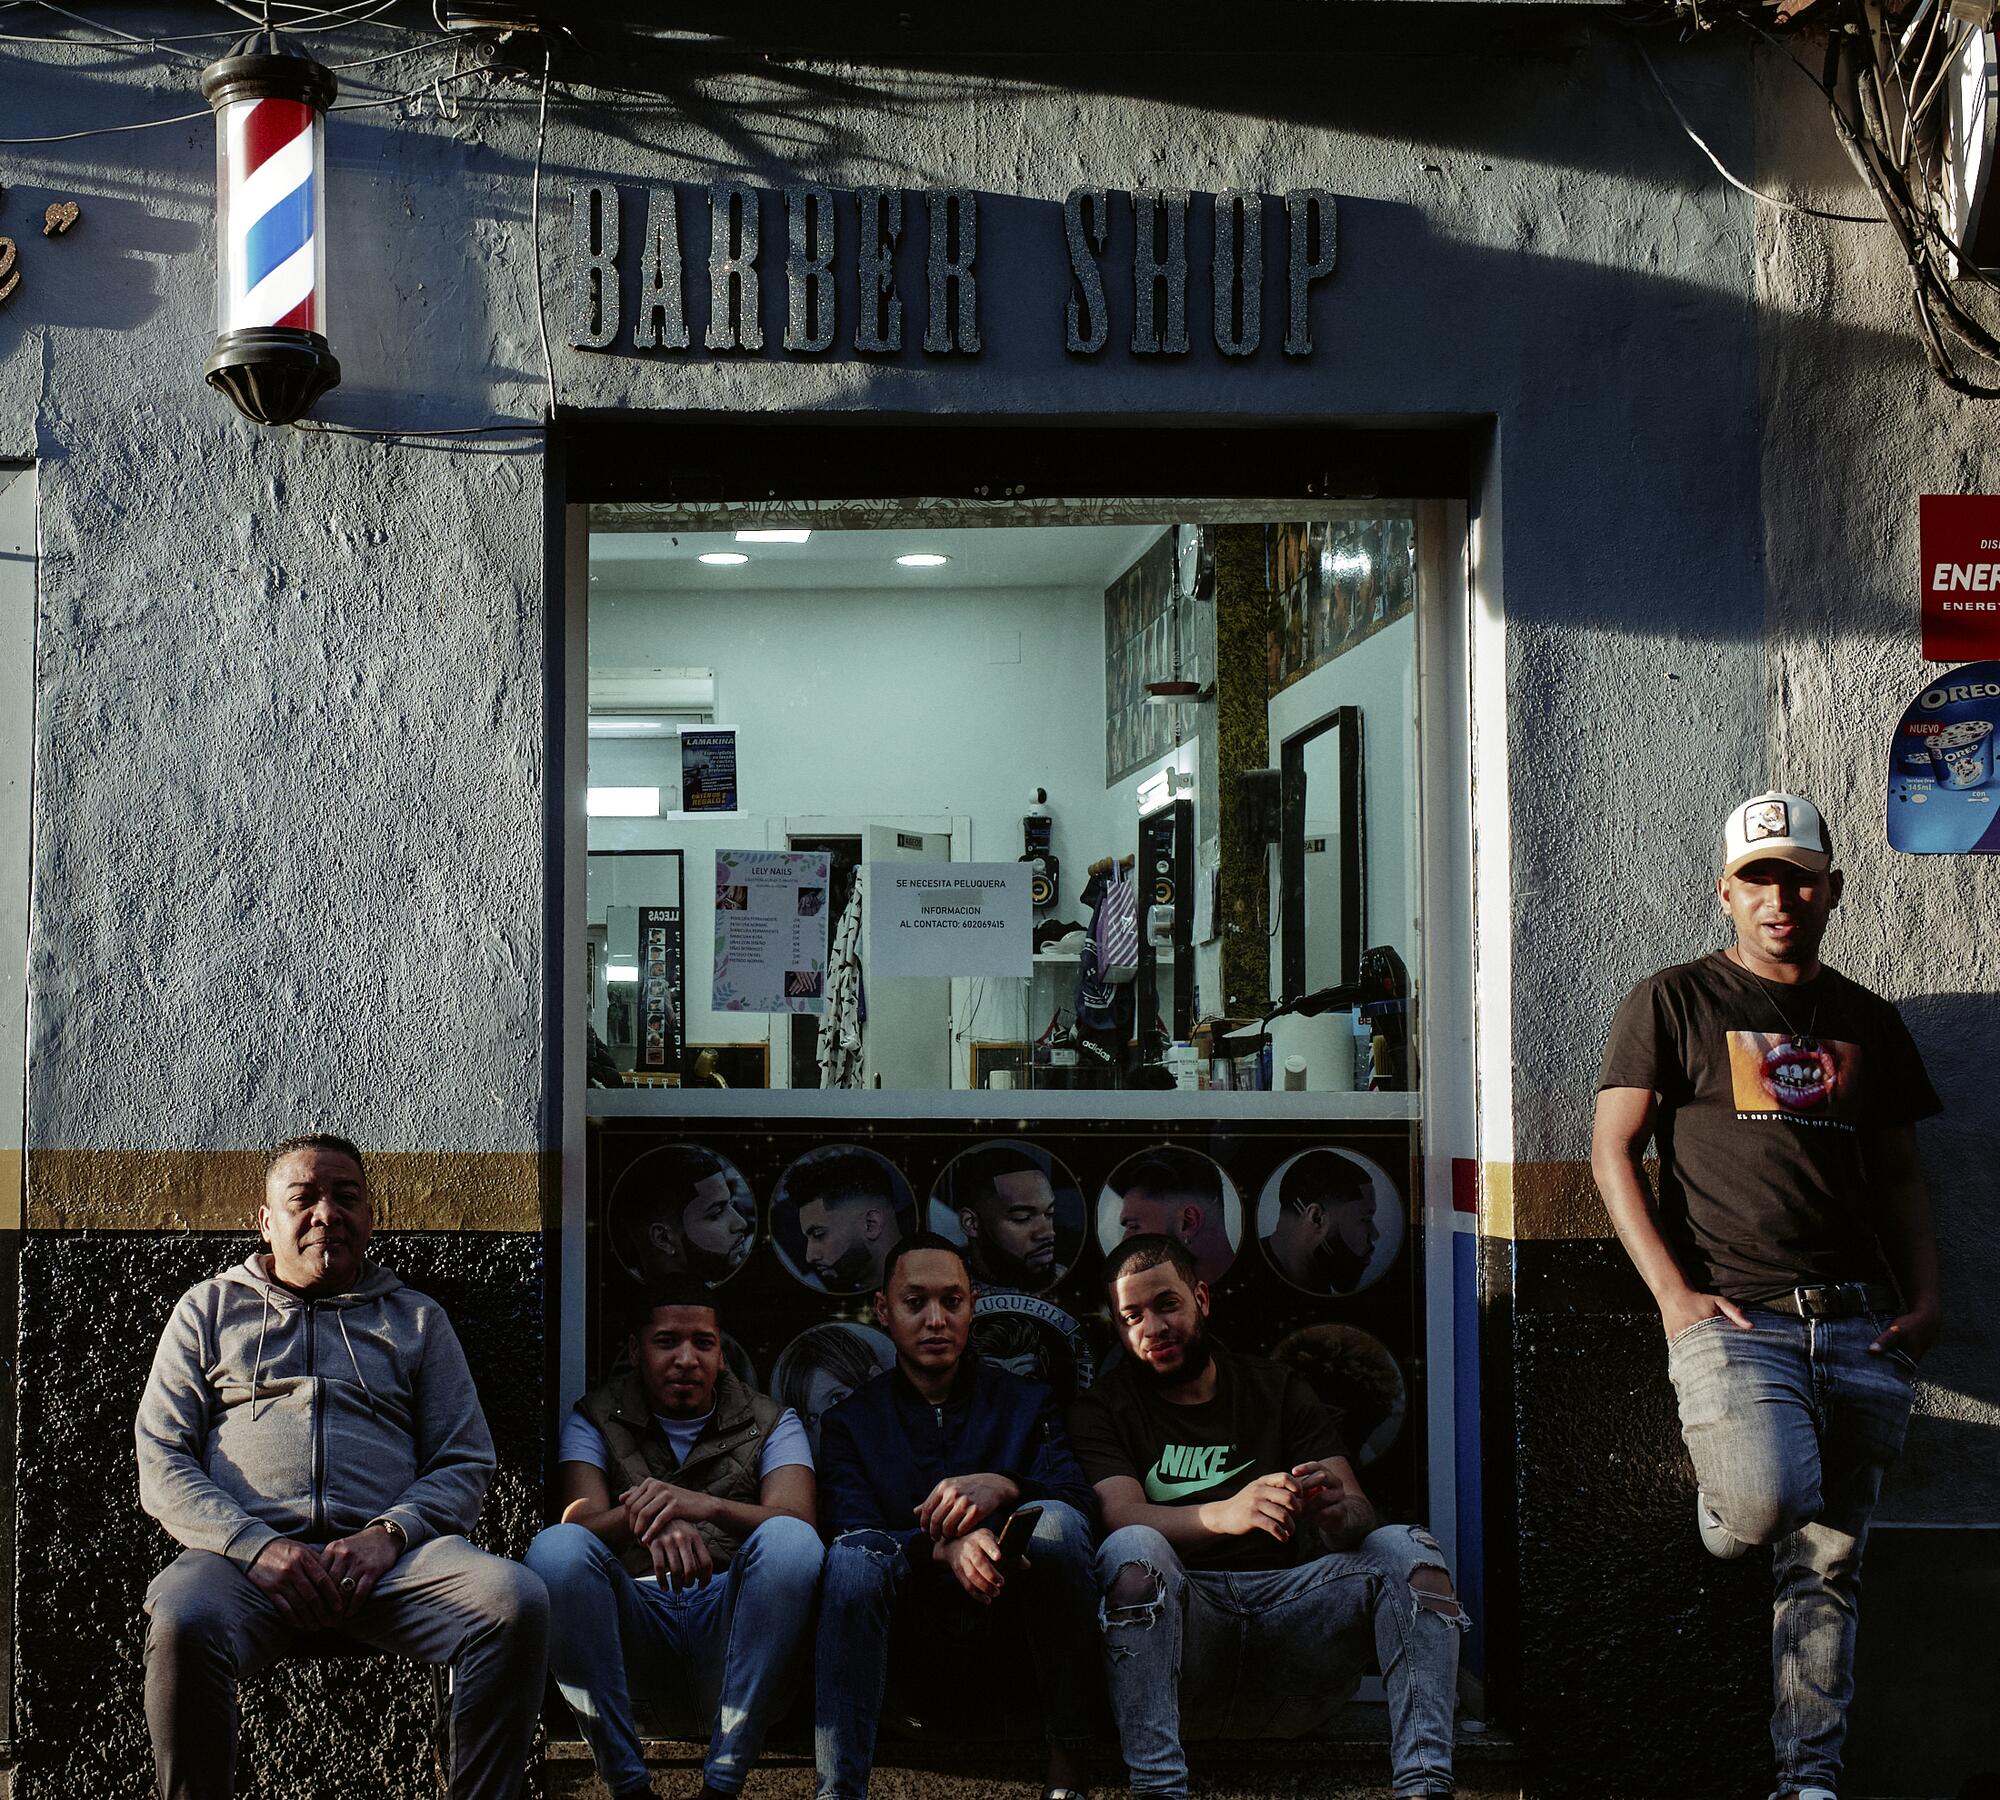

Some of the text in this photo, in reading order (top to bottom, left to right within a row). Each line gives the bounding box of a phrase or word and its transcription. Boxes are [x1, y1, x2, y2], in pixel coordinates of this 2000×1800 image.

[569, 184, 1338, 356] BARBER SHOP
[1980, 539, 2000, 549] DIS
[1943, 602, 2000, 611] ENERG
[1921, 683, 2000, 709] OREO
[1909, 723, 1940, 735] NUEVO
[1944, 744, 1978, 762] OREO
[752, 867, 792, 876] LELY NAILS
[896, 879, 1007, 888] SE NECESITA PELUQUERA
[921, 906, 981, 915] INFORMACION
[900, 919, 1005, 929] AL CONTACTO: 602069415
[1082, 1040, 1111, 1062] adidas
[1736, 1113, 1748, 1121] EL
[979, 1296, 1067, 1328] UQUERIA
[1159, 1444, 1231, 1480] NIKE
